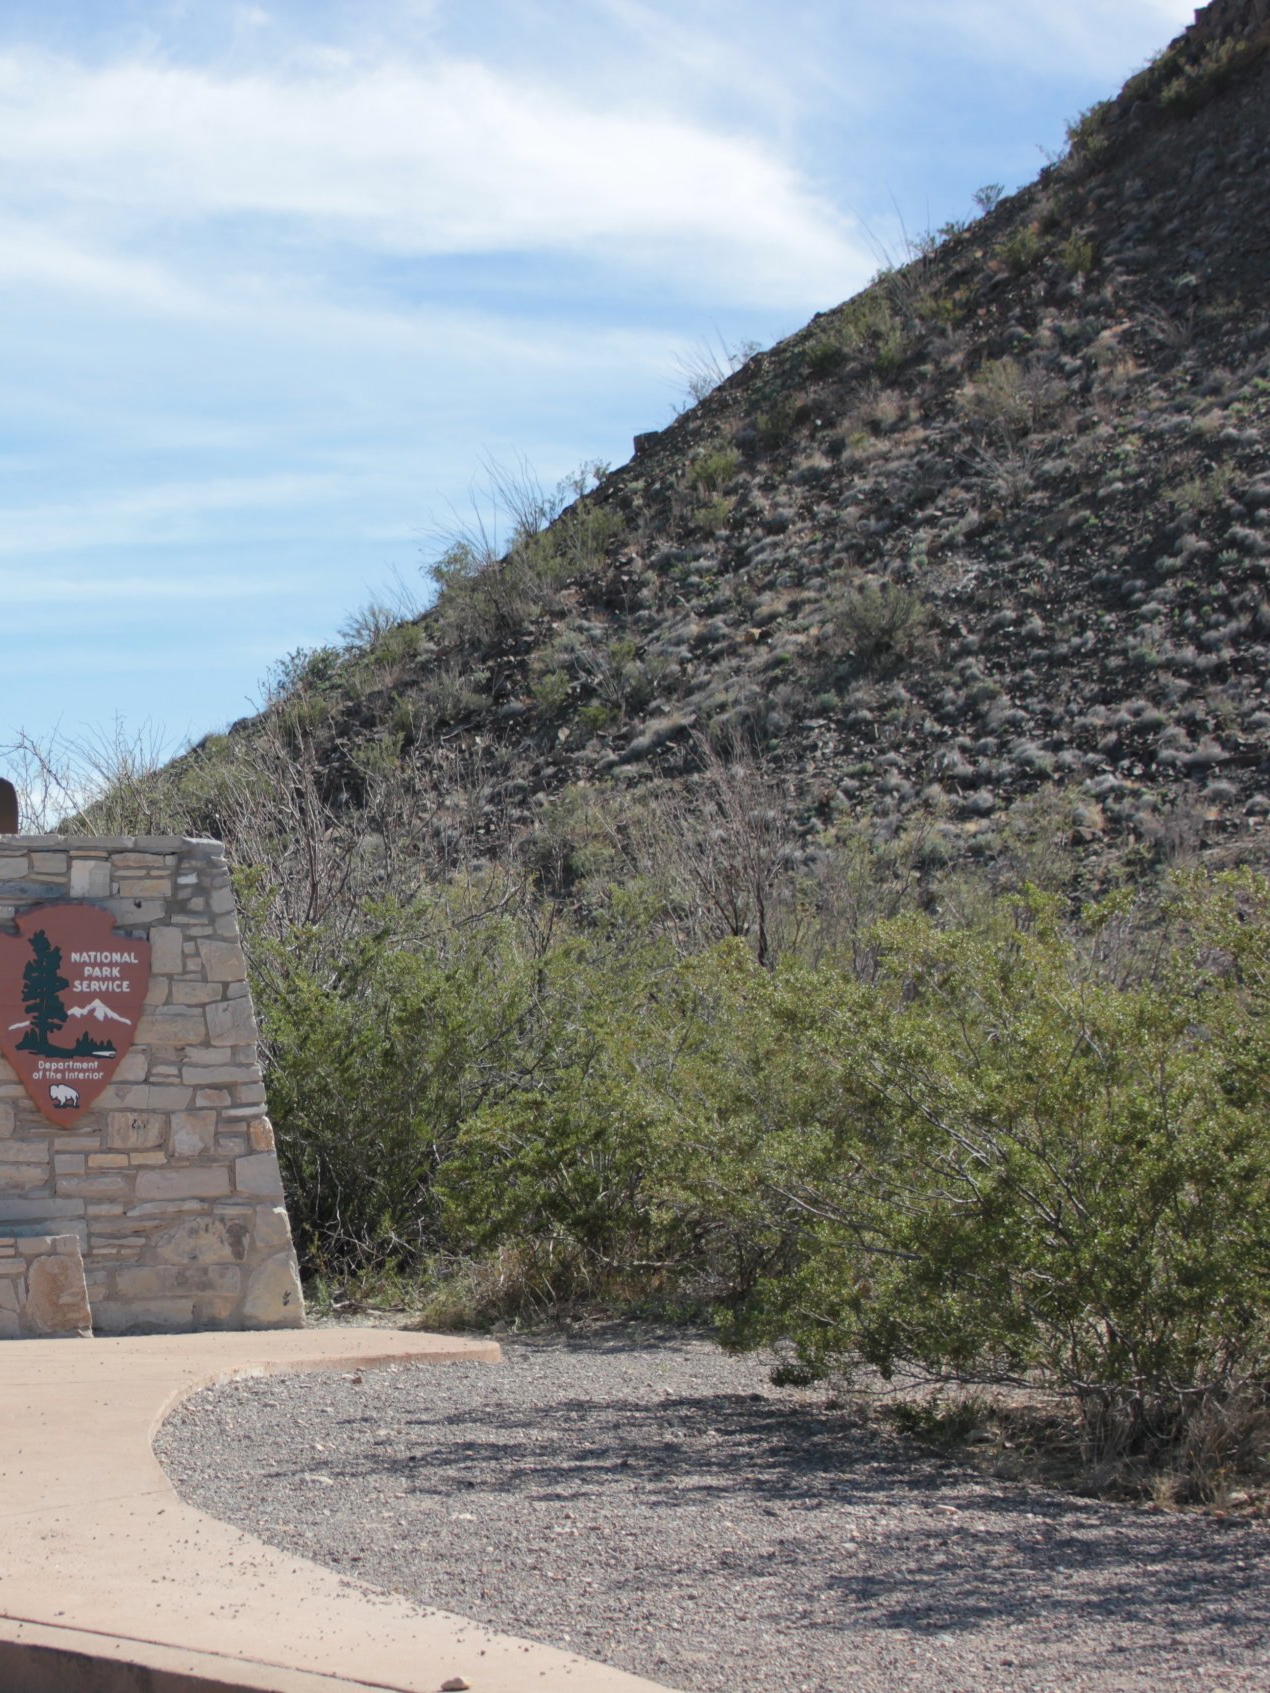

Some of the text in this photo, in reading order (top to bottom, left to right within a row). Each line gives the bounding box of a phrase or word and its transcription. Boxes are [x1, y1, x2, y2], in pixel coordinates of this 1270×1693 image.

[71, 951, 139, 964] NATIONAL
[84, 966, 120, 978] PARK
[73, 980, 130, 993] SERVICE
[38, 1060, 99, 1071] Department
[32, 1070, 104, 1080] of the Interior
